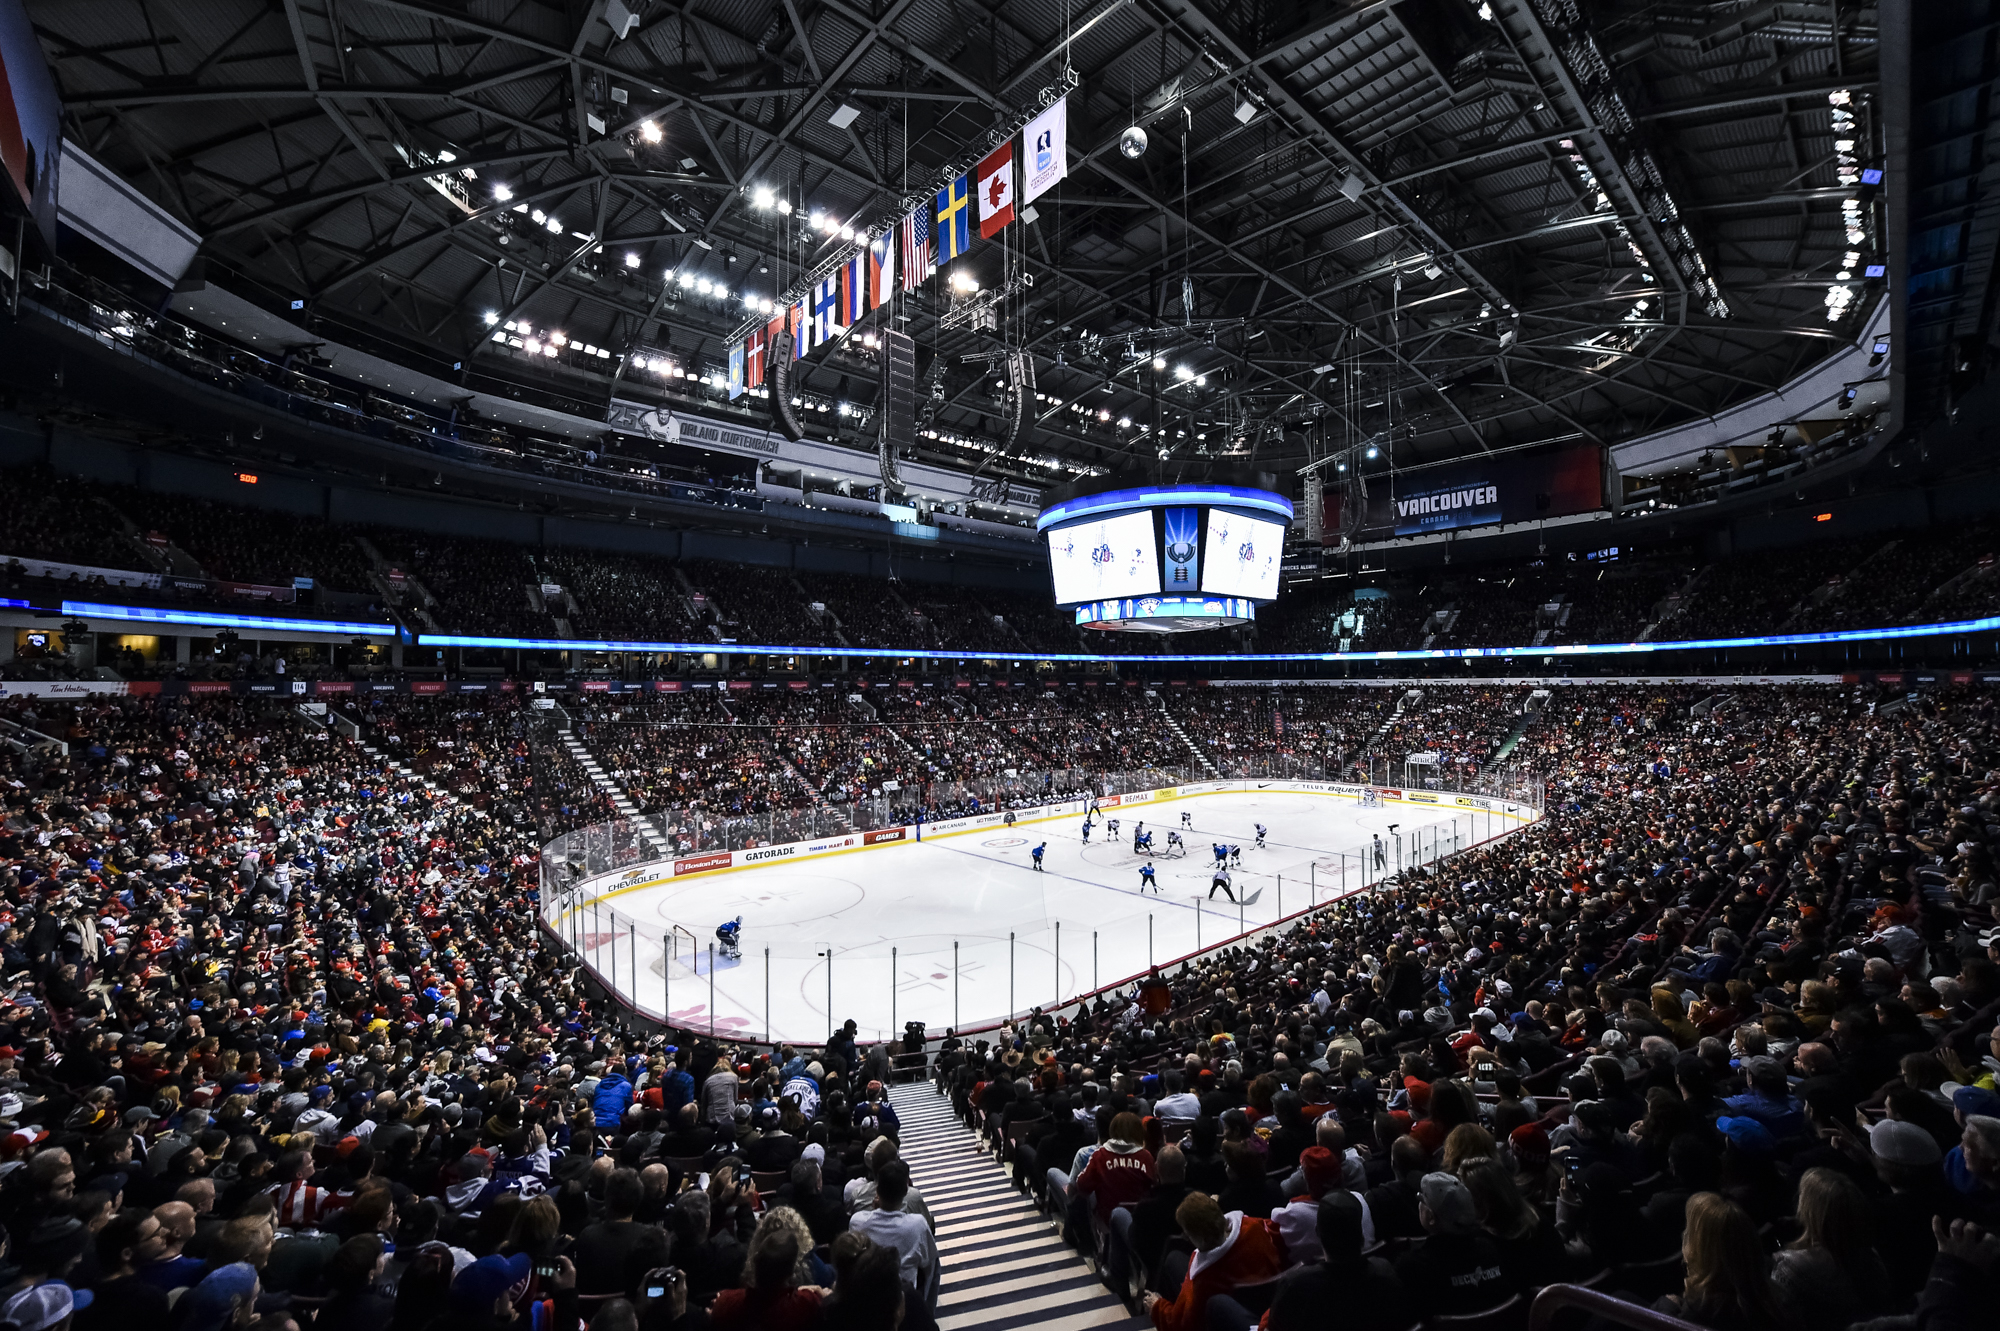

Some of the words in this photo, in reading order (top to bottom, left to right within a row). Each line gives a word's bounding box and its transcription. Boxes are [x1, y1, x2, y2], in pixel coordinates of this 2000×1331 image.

[609, 405, 638, 430] 25
[681, 422, 718, 441] ORLAND
[720, 430, 780, 454] KURTENBACH
[1450, 480, 1490, 491] CHAMPIONSHIP
[1008, 490, 1031, 504] HAROLD
[1397, 485, 1498, 517] VANCOUVER
[1420, 515, 1449, 525] CANADA
[50, 684, 63, 693] Tim
[63, 684, 91, 693] Hortons
[293, 682, 306, 691] 114
[1125, 793, 1149, 803] RE/MAX
[1455, 797, 1473, 806] OK
[1475, 800, 1490, 809] TIRE
[947, 821, 967, 829] CANADA
[984, 815, 1002, 823] TISSOT
[875, 832, 900, 842] GAMES
[745, 847, 795, 861] GATORADE
[684, 860, 711, 870] Boston
[711, 858, 731, 867] Pizza
[608, 873, 661, 892] CHEVROLET
[1105, 1157, 1147, 1174] CANADA
[1450, 1273, 1477, 1287] DECK
[1481, 1265, 1503, 1281] CREW
